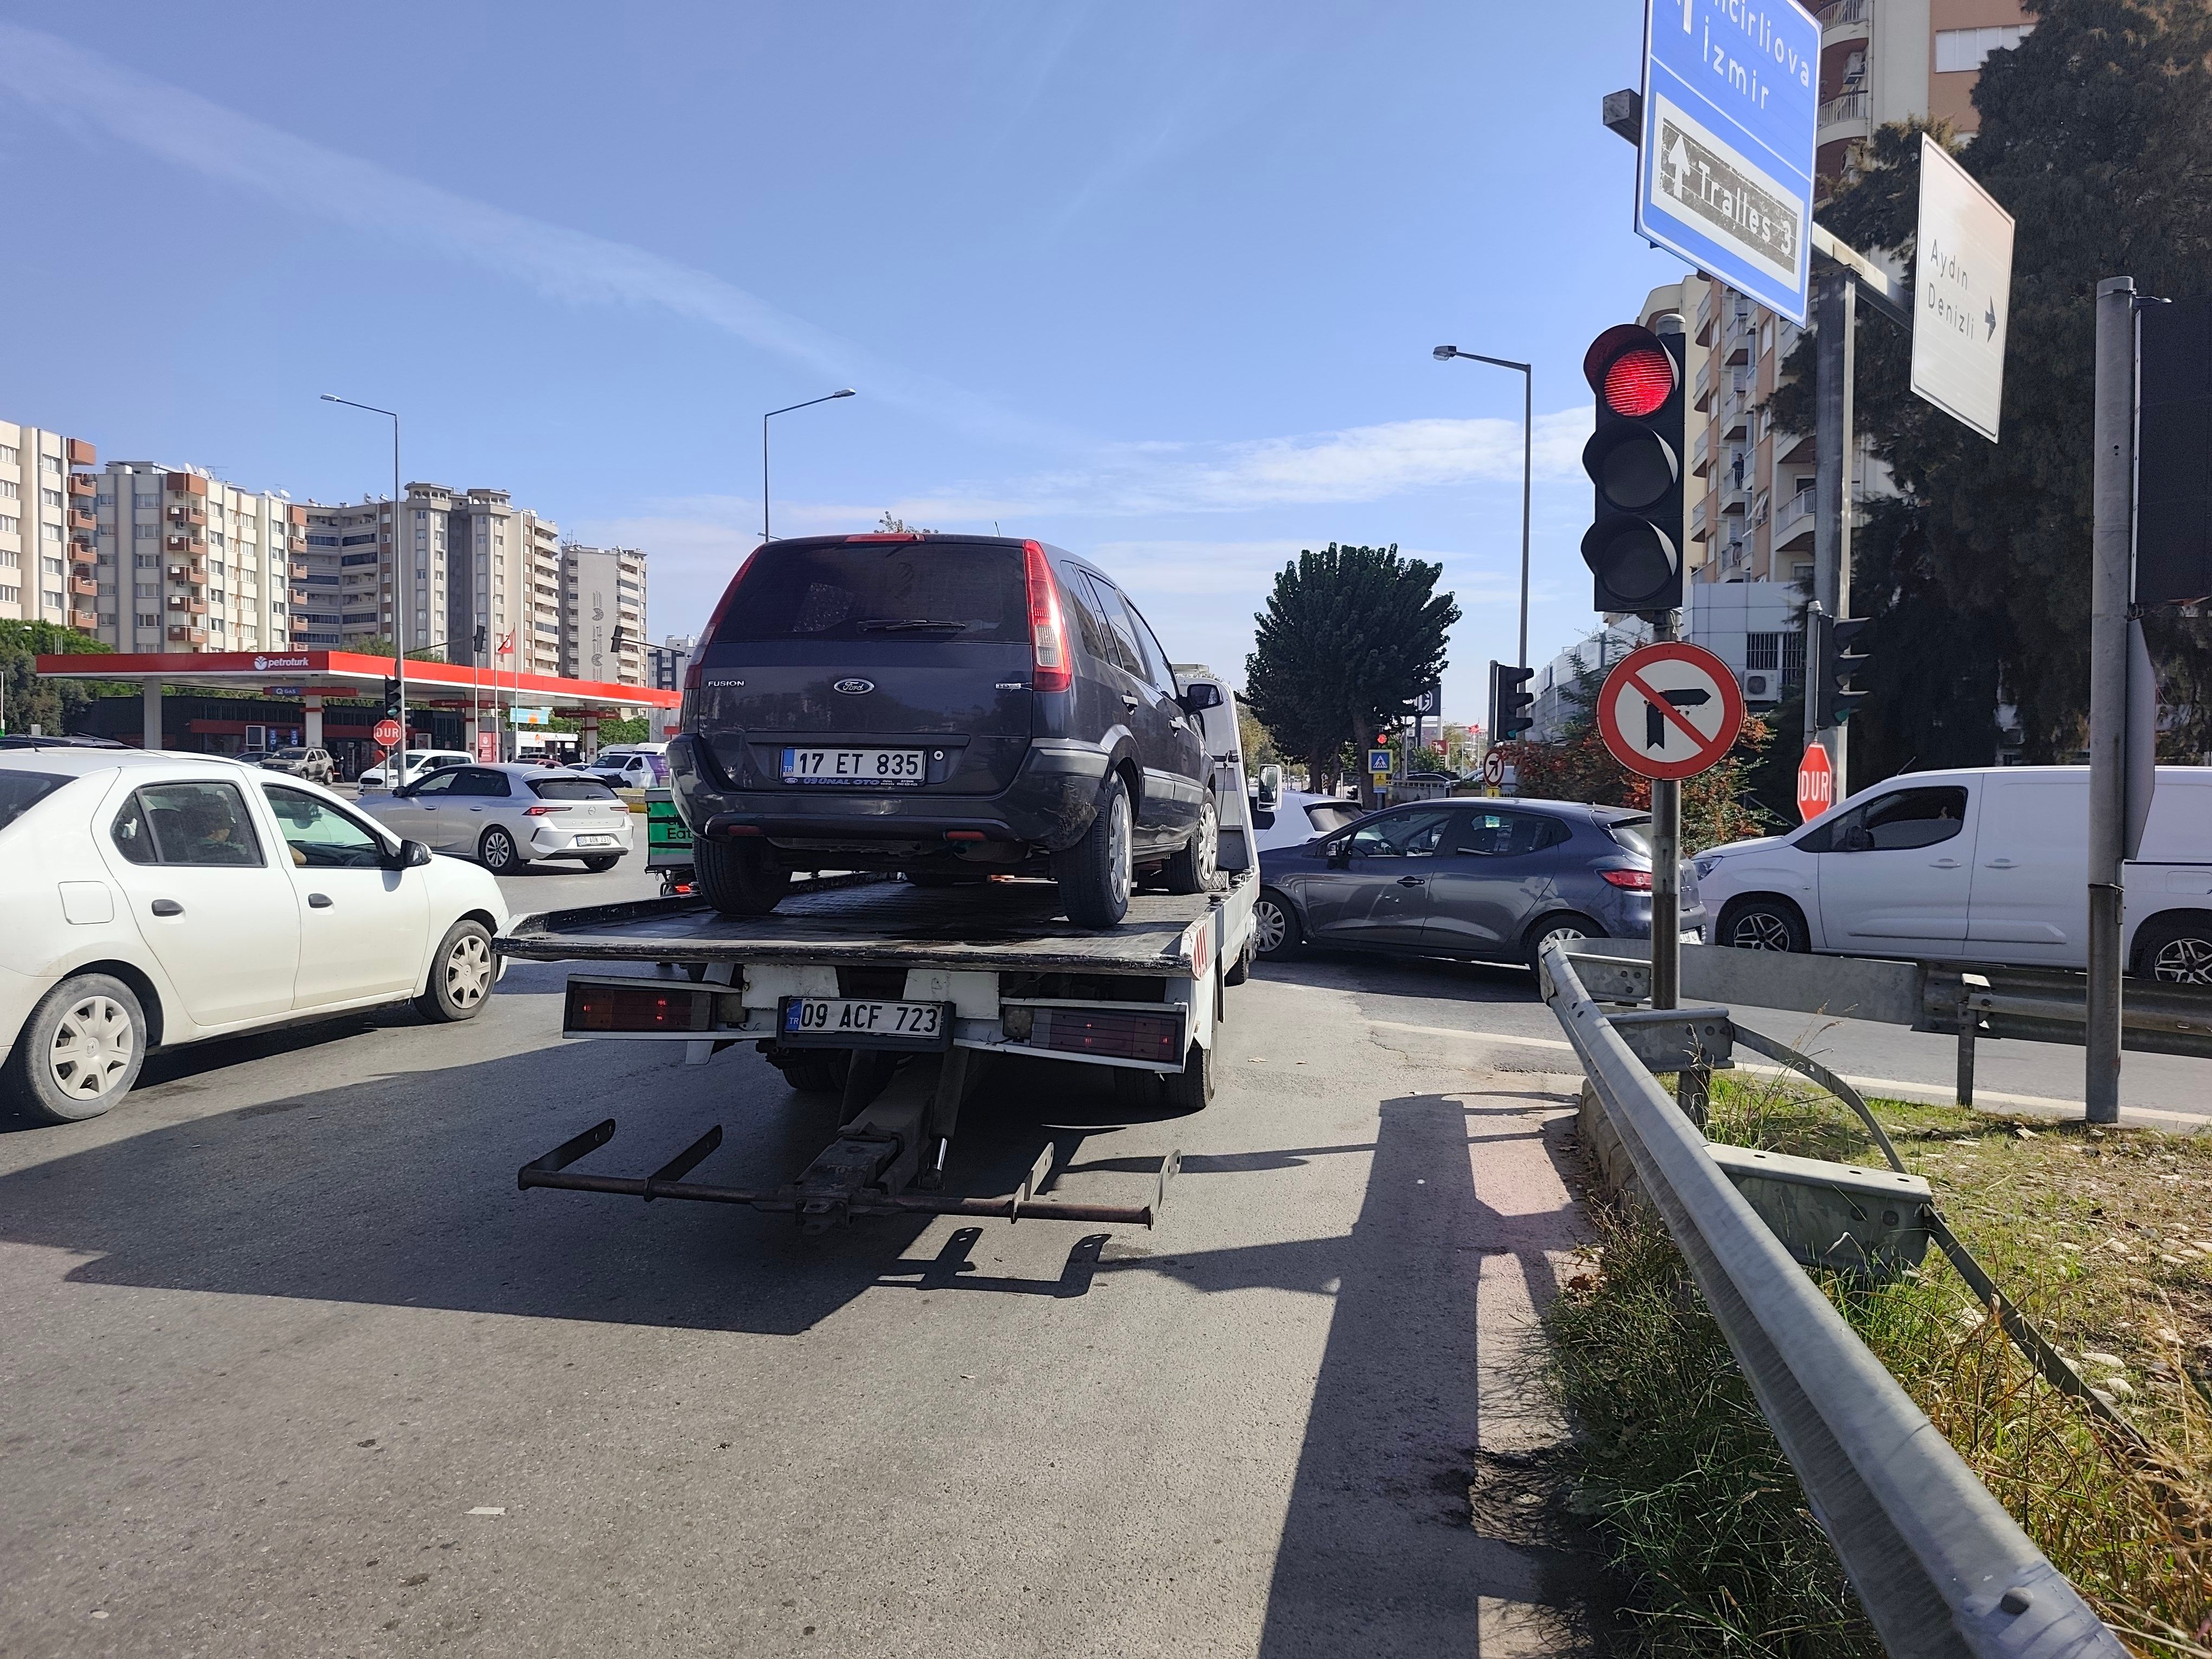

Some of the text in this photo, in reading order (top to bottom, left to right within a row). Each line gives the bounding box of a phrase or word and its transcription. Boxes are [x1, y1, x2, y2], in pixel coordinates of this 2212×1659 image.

[1714, 0, 1809, 88] cirliova
[1698, 160, 1791, 255] Tralles 3
[1930, 239, 1967, 290] Aydın
[1928, 282, 1974, 340] Denizli
[268, 657, 310, 668] petroturk
[843, 681, 864, 691] Ford
[376, 728, 399, 738] DUR
[800, 753, 824, 774] 17
[836, 753, 864, 774] ET
[876, 754, 919, 775] 835
[1801, 770, 1829, 802] DUR
[667, 827, 693, 839] Eat
[801, 1004, 828, 1028] 09
[839, 1004, 883, 1029] ACF
[895, 1007, 938, 1033] 723
